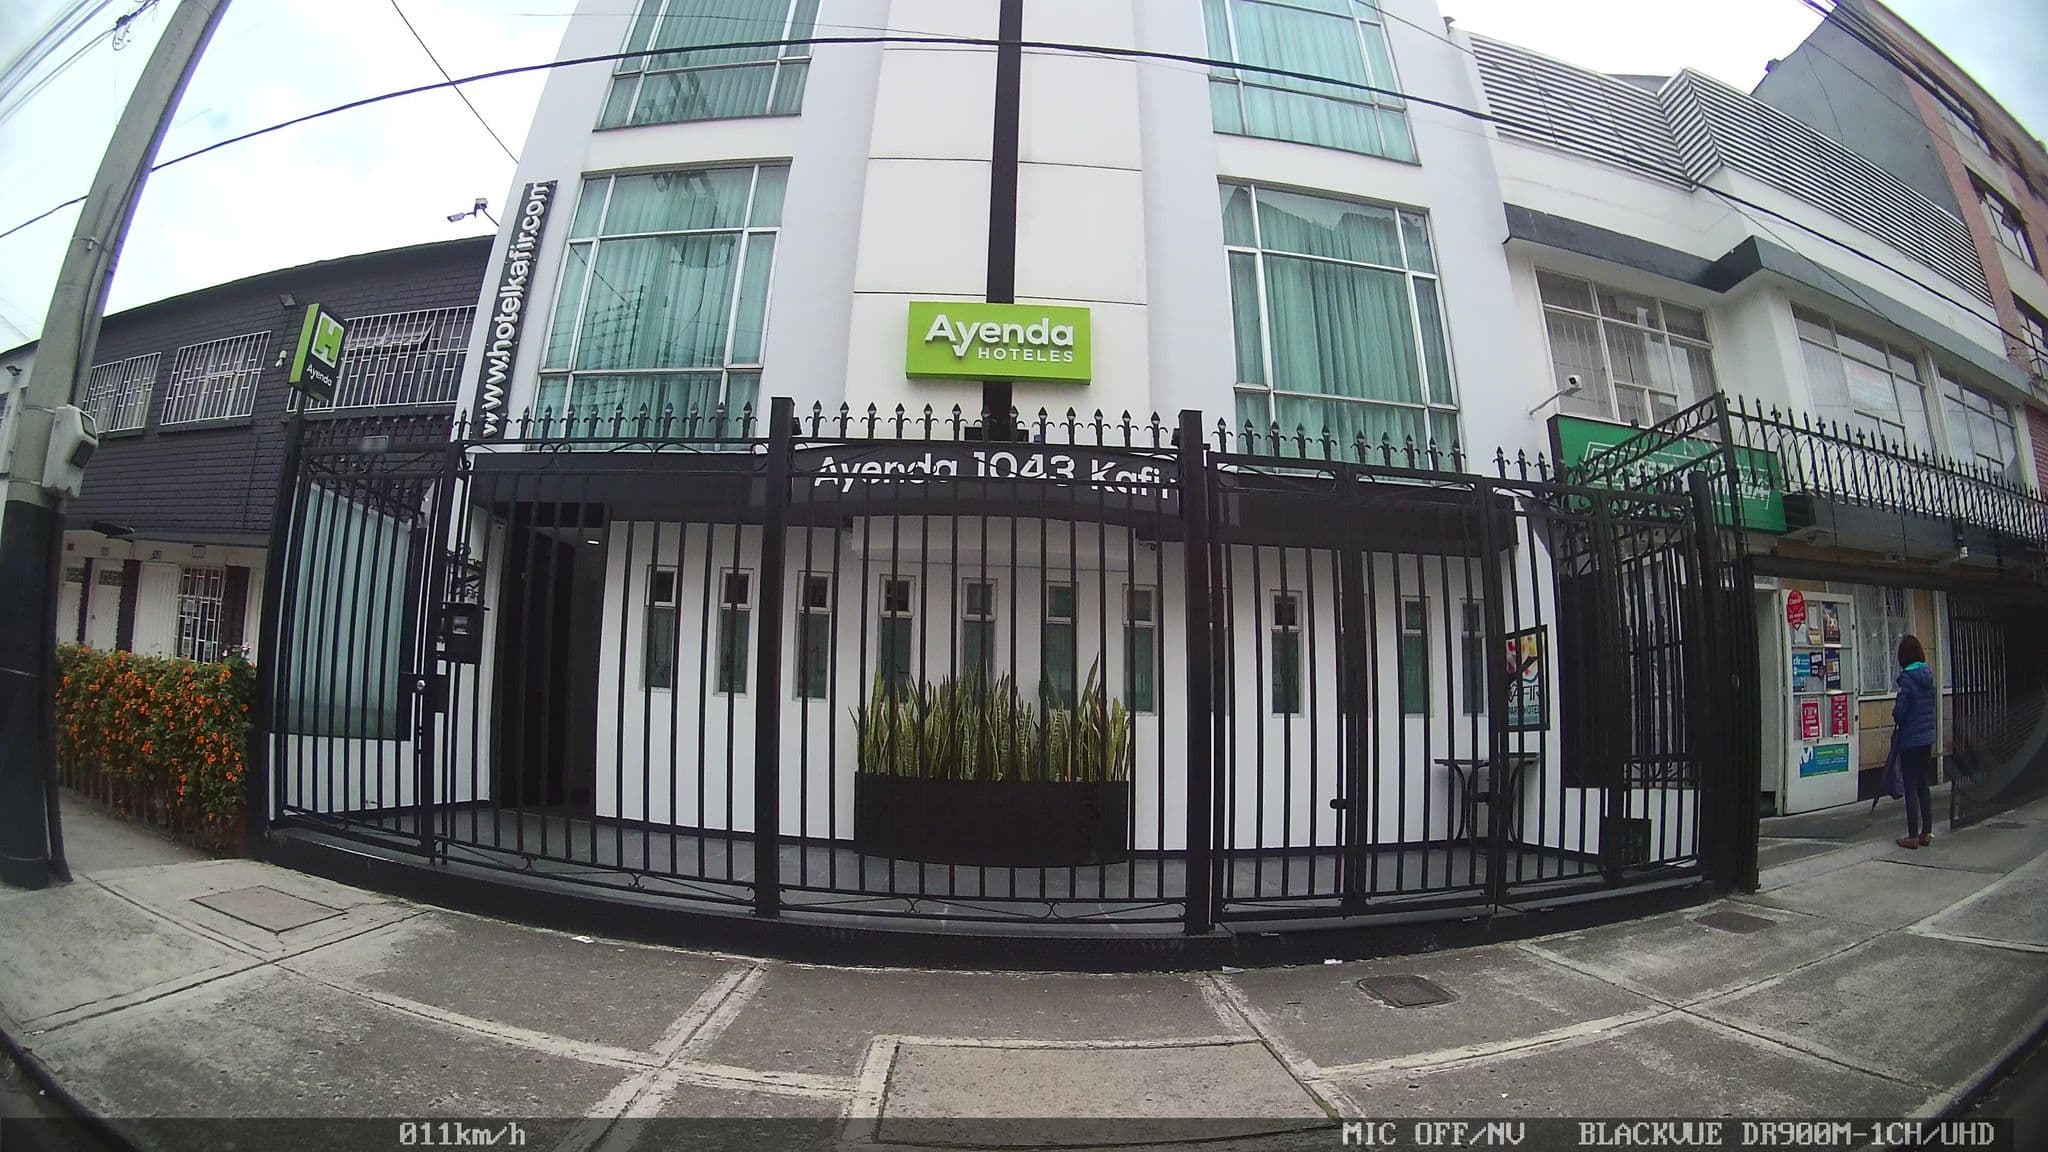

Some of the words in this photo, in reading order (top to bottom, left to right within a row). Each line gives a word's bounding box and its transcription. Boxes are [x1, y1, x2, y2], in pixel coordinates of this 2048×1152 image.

[481, 182, 550, 438] www.hotelkafir.com
[924, 313, 1075, 357] Ayenda
[978, 346, 1074, 363] HOTELES
[306, 363, 333, 387] Ayenda
[814, 453, 958, 492] Ayenda
[973, 451, 1075, 487] 1043
